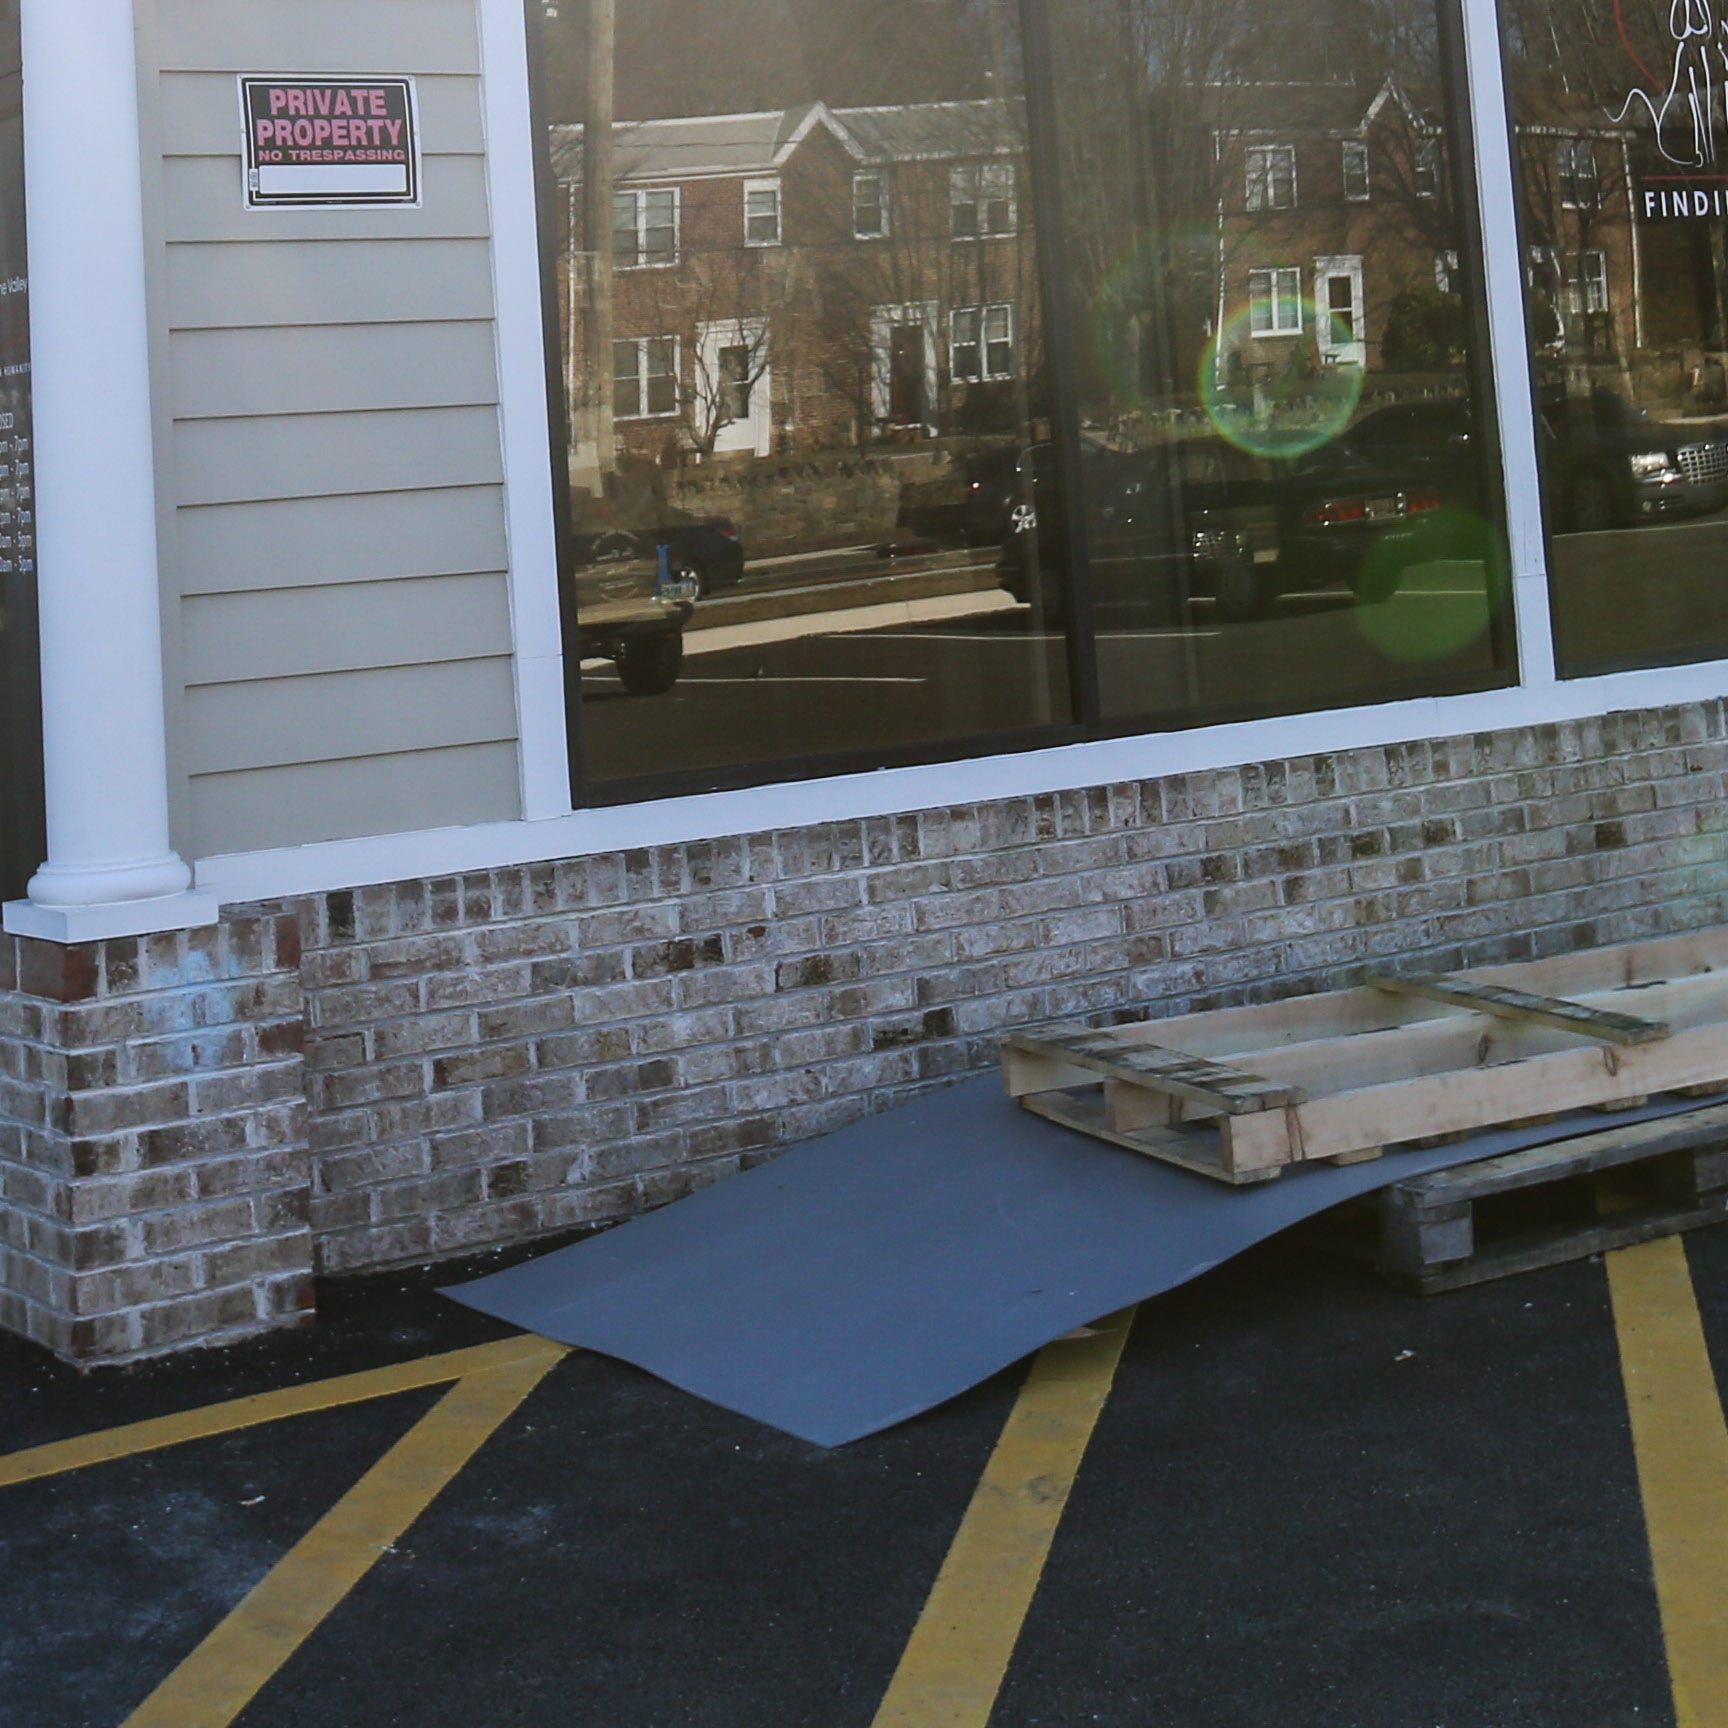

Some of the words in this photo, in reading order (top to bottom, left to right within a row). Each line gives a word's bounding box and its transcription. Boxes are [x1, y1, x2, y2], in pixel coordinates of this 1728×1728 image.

[268, 88, 388, 116] PRIVATE
[256, 118, 403, 147] PROPERTY
[258, 149, 283, 161] NO
[288, 148, 406, 161] TRESPASSING
[7, 276, 28, 294] Valley
